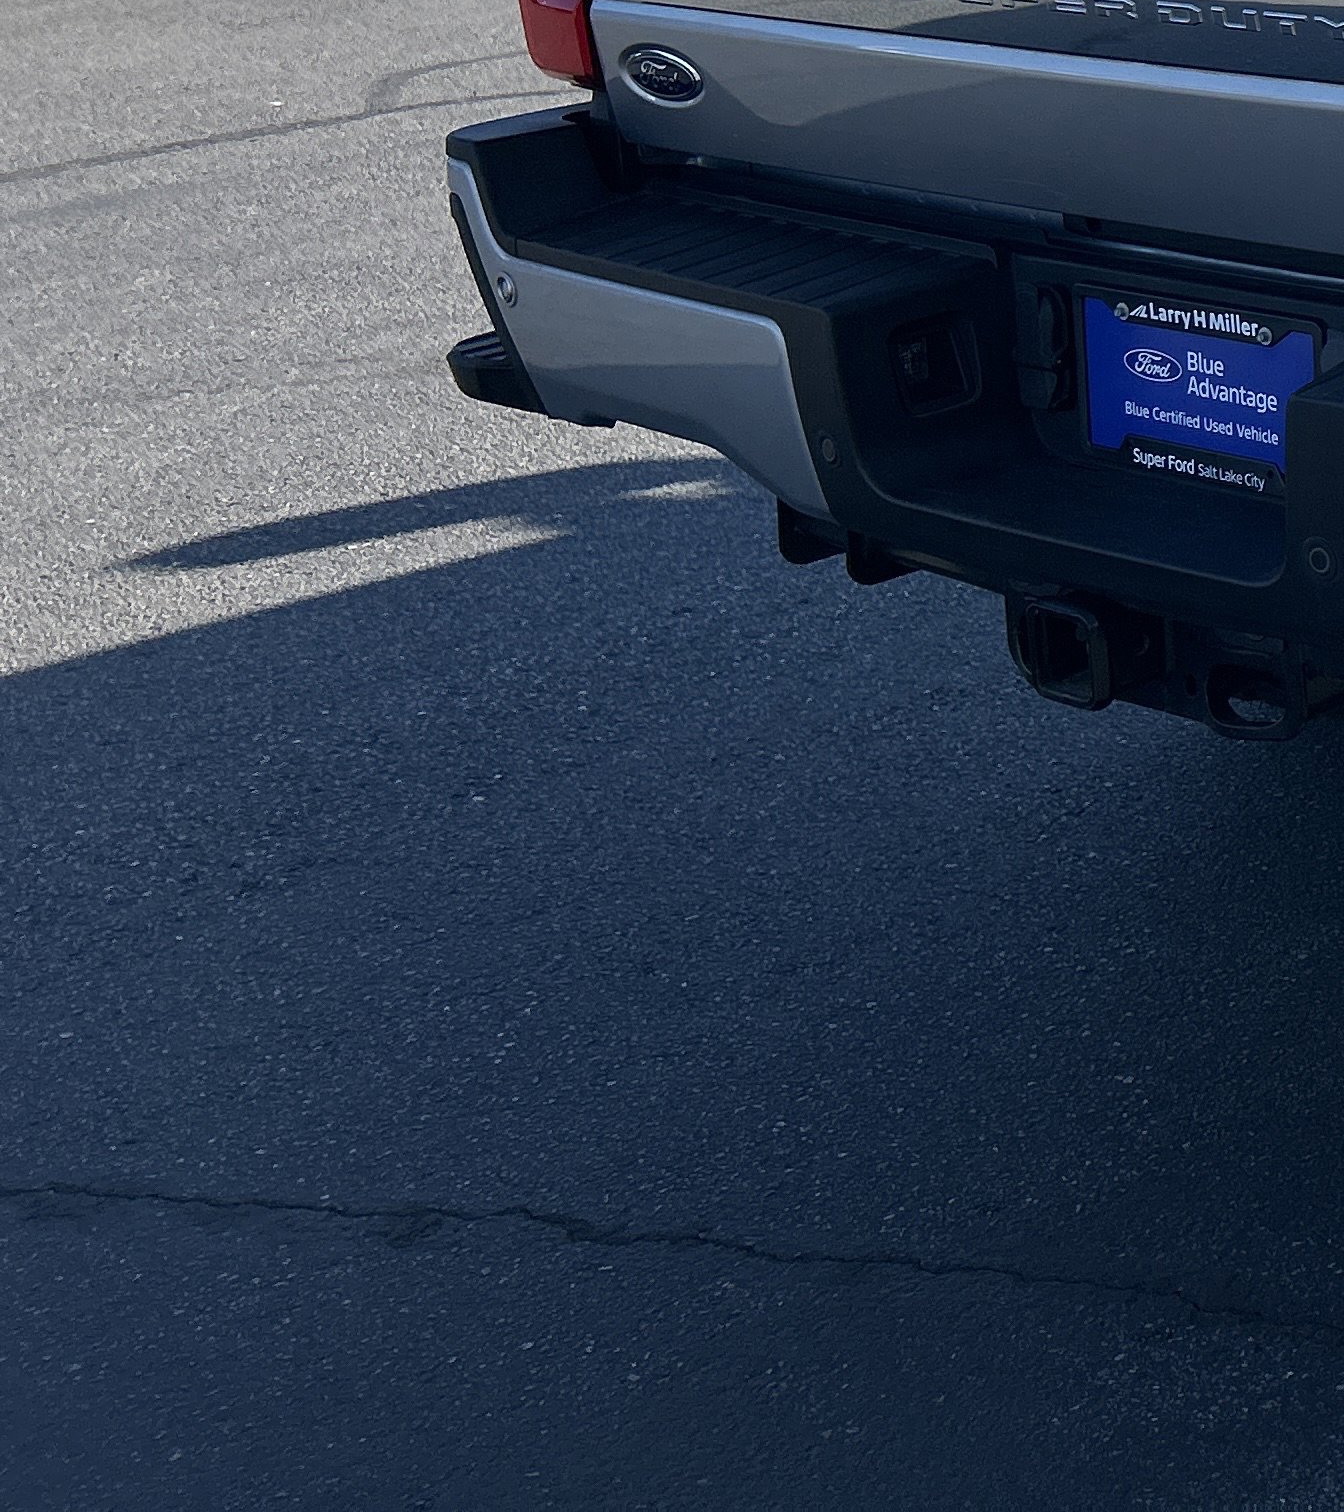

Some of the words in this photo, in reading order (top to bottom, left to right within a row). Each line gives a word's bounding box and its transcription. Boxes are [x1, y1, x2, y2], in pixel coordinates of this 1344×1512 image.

[1149, 302, 1191, 330] Larry
[1193, 309, 1207, 329] H
[1209, 312, 1259, 337] Miller
[1134, 352, 1171, 378] Ford
[1187, 351, 1224, 377] Blue
[1187, 375, 1278, 413] Advantage
[1124, 400, 1150, 419] Blue
[1152, 406, 1200, 429] Certified
[1203, 416, 1233, 436] Used
[1236, 423, 1279, 446] Vehicle
[1132, 447, 1166, 469] Super
[1168, 454, 1195, 475] Ford
[1198, 463, 1218, 480] Salt
[1219, 467, 1243, 485] Lake
[1244, 473, 1266, 492] City
